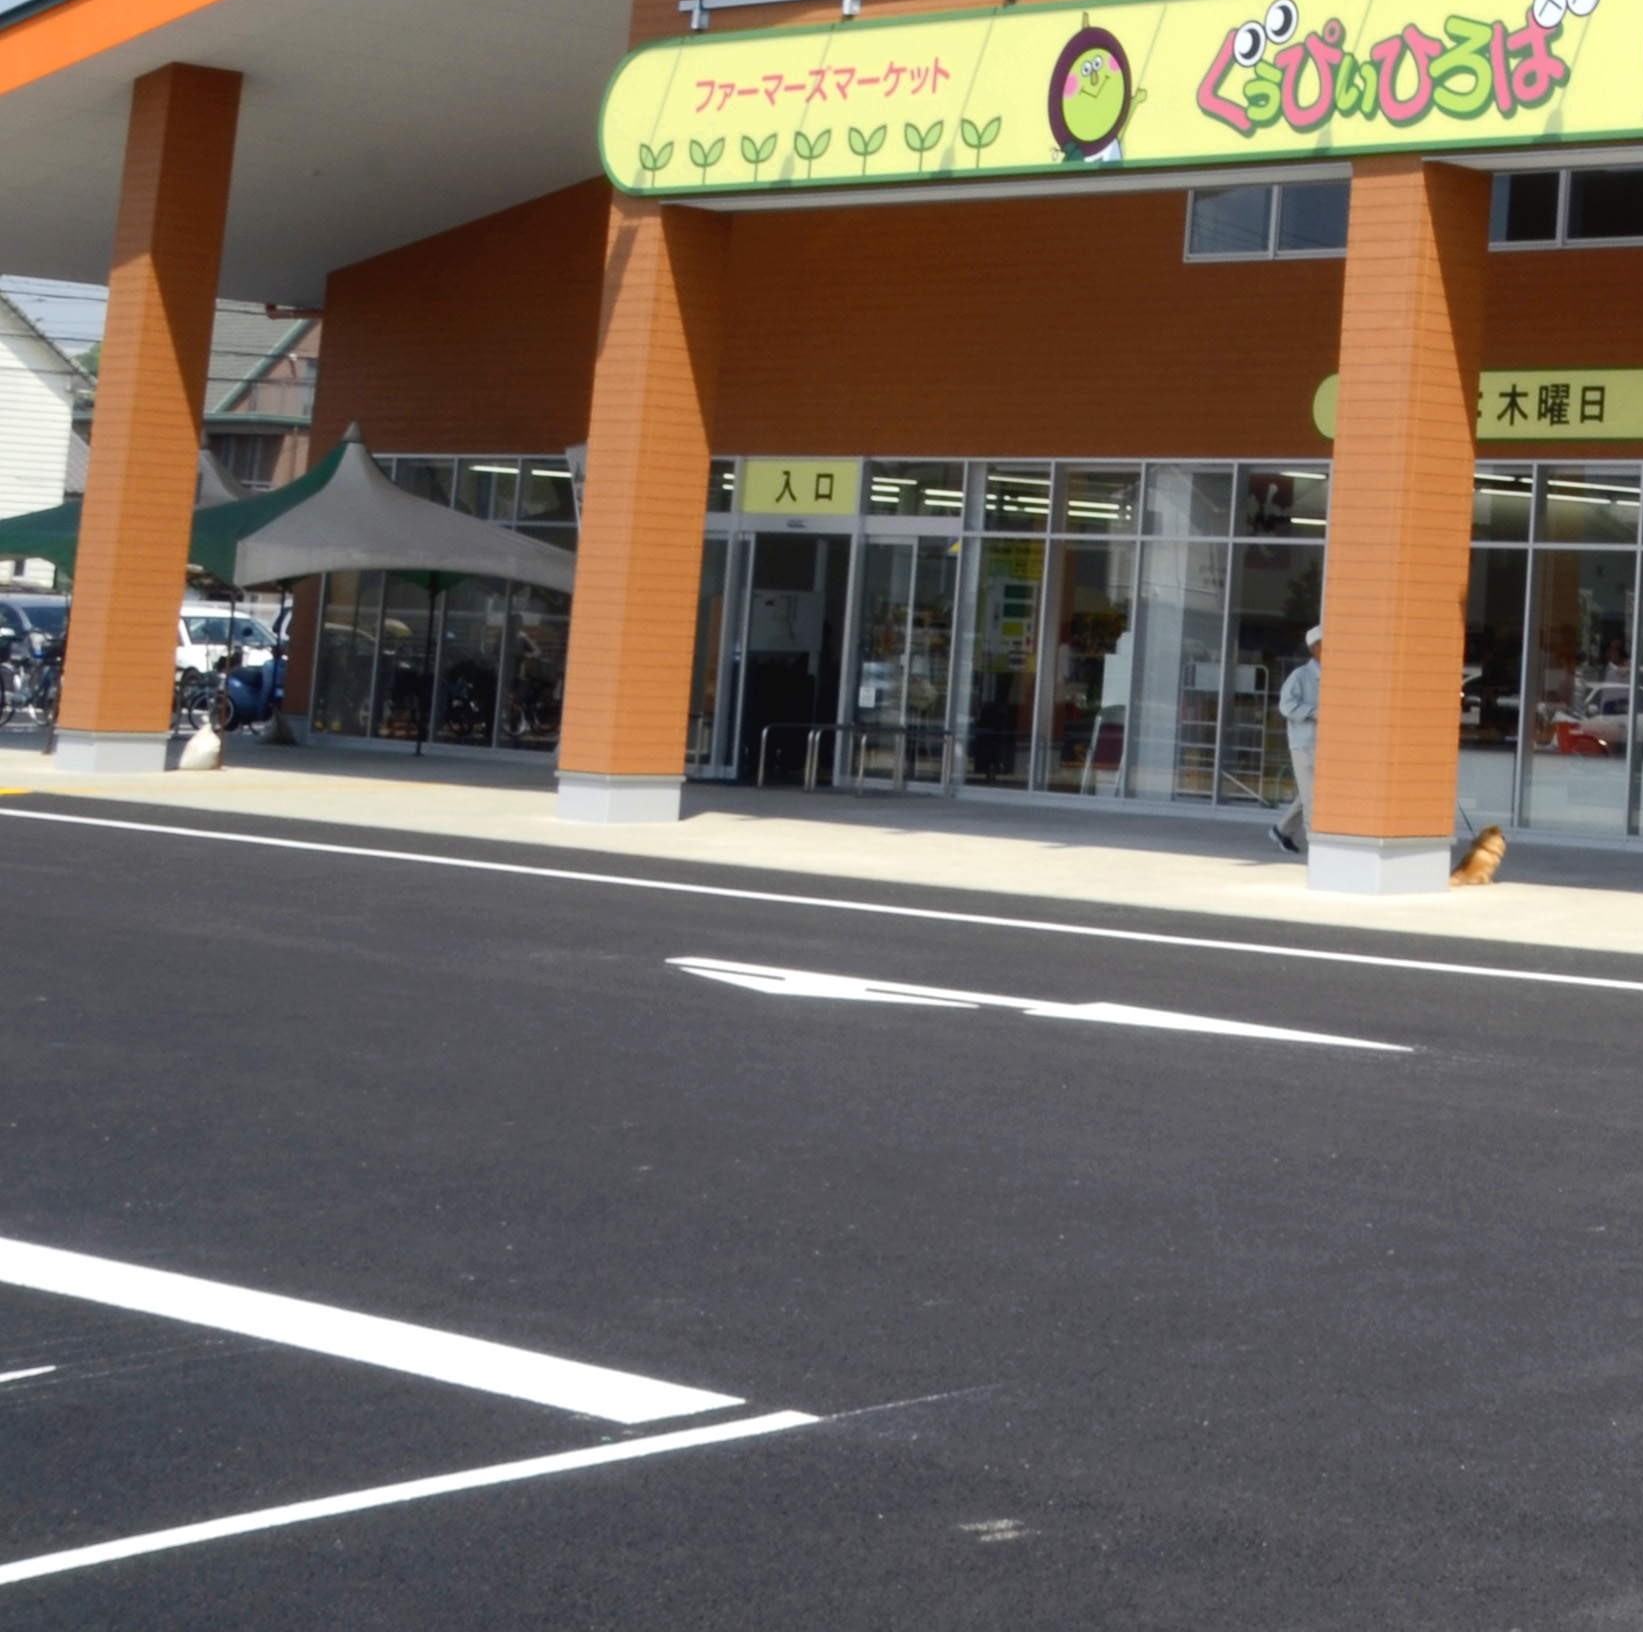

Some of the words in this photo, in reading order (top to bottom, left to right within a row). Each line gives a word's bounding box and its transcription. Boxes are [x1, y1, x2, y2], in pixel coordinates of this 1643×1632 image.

[695, 56, 951, 113] ファーマーズマーケット
[775, 470, 835, 504] 入口
